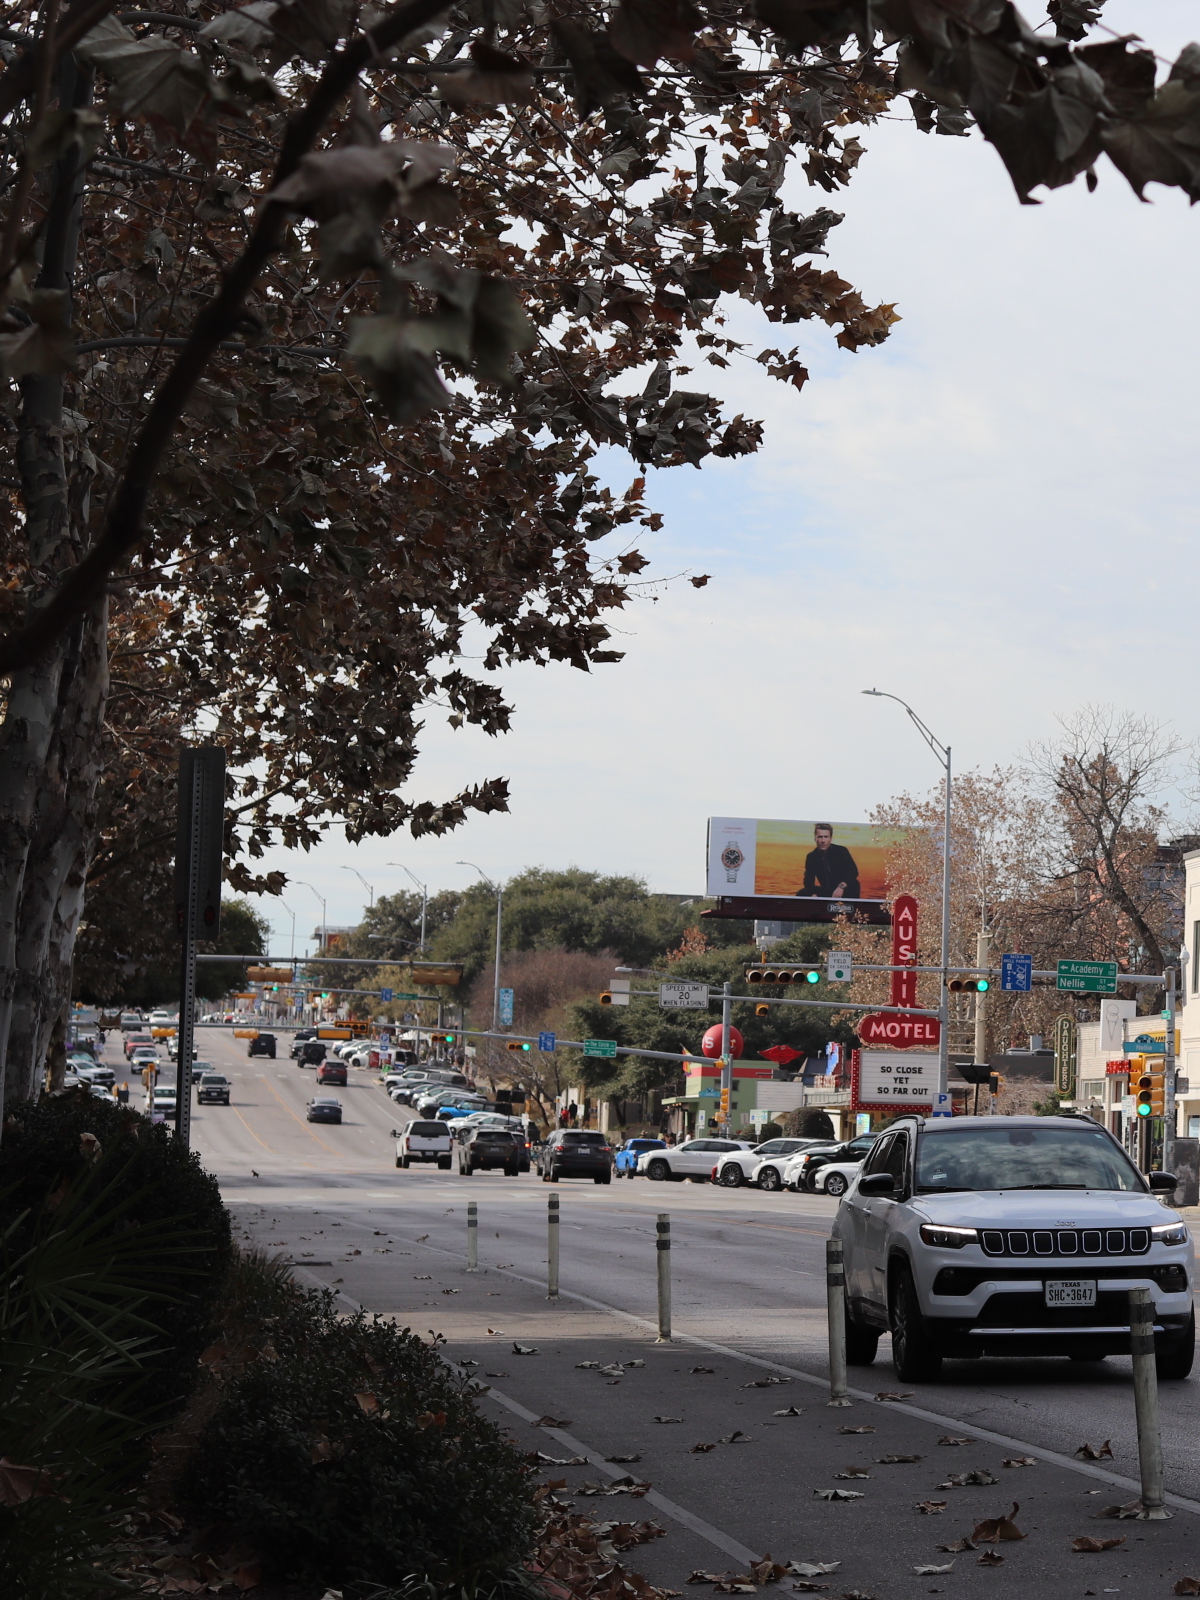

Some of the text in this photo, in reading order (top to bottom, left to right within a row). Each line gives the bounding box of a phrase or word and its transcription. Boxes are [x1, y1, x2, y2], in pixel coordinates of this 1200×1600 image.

[1070, 963, 1104, 975] Academy
[1060, 978, 1085, 988] Nellie
[870, 1021, 936, 1038] MOTEL
[896, 1066, 923, 1074] CLOSE
[893, 1076, 909, 1084] YET
[877, 1086, 928, 1095] SO FAR OUT
[939, 1094, 947, 1104] P
[1048, 1288, 1093, 1301] SHC 3647
